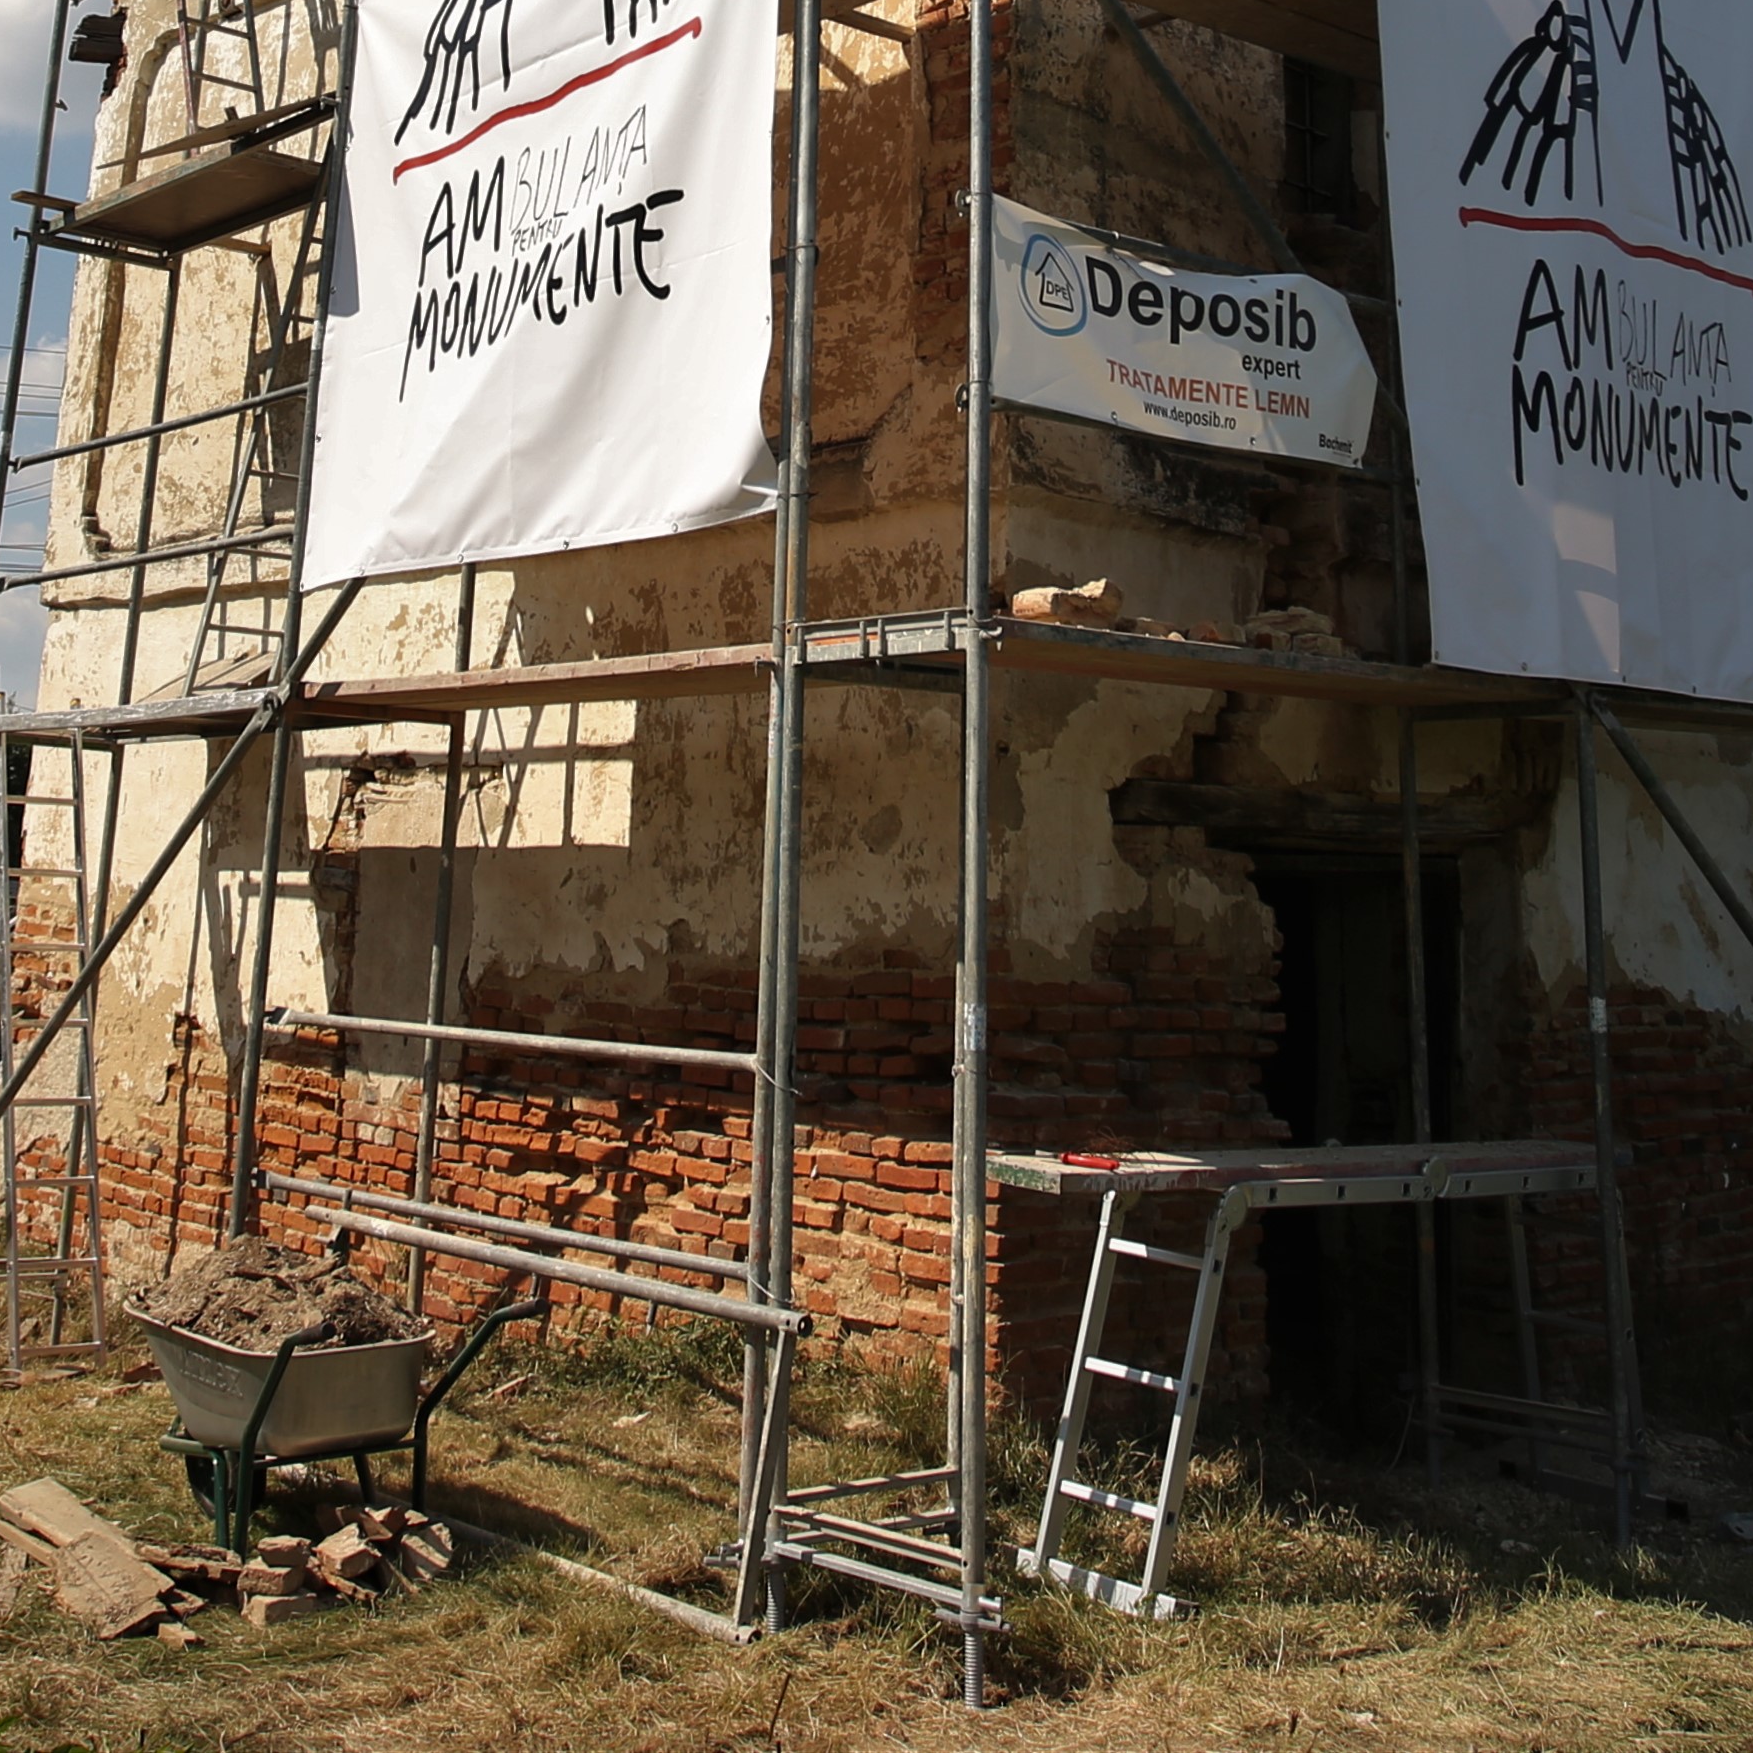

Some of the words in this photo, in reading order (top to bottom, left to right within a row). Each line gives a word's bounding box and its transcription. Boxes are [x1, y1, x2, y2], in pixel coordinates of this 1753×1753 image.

[510, 217, 564, 258] PENTRU
[399, 189, 685, 403] MONUMENTE
[1046, 280, 1070, 302] DPE
[1085, 255, 1317, 352] Deposib
[1241, 353, 1301, 381] expert
[1625, 360, 1665, 397] PENTRU
[1106, 358, 1249, 410] TRATAMENTE
[1255, 388, 1311, 420] LEMN
[1143, 400, 1237, 431] www.deposib.ro
[1511, 363, 1753, 502] MONUMENTE
